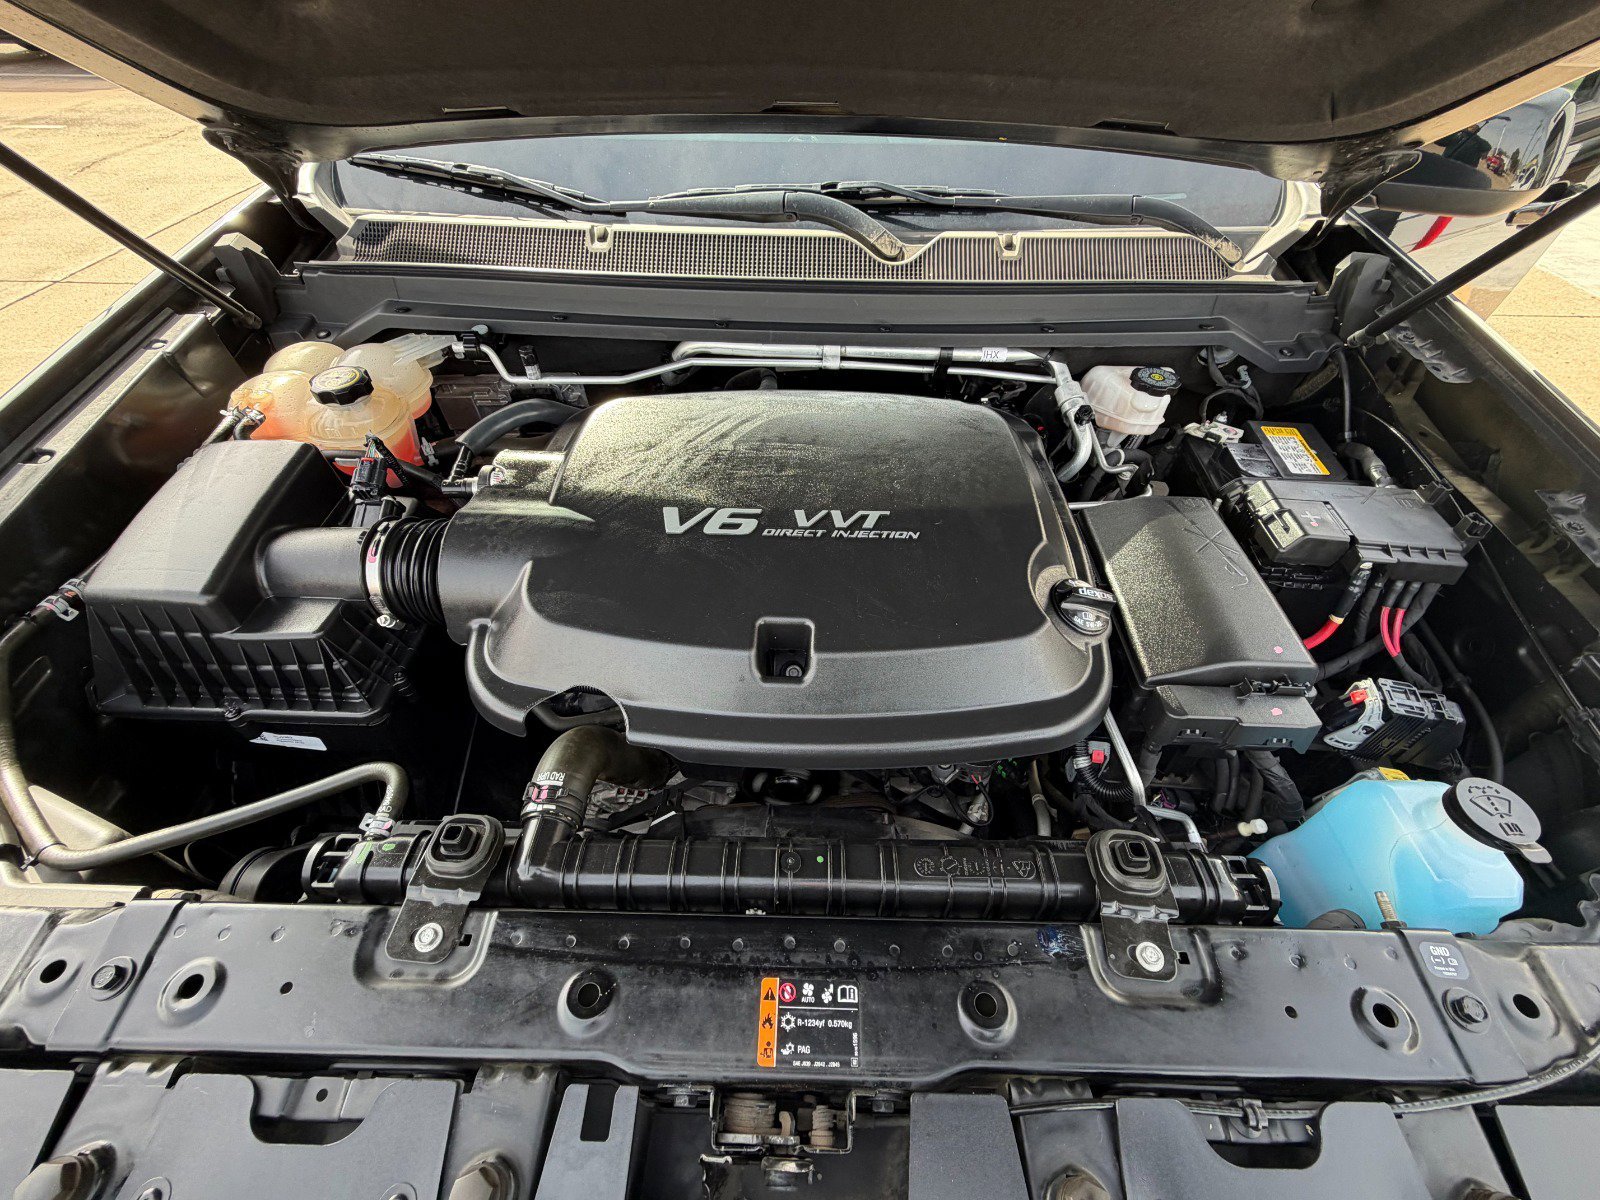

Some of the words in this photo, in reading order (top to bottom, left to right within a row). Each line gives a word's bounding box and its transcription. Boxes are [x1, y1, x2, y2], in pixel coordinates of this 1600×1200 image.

[662, 506, 763, 536] V6
[793, 509, 891, 529] VVT
[761, 528, 827, 538] DIRECT
[831, 529, 921, 539] INJECTION
[549, 771, 566, 781] RAD
[1429, 945, 1450, 957] GND
[801, 996, 815, 1004] AUTO
[797, 1018, 826, 1029] R-1234yf
[827, 1019, 853, 1030] 0.570kg
[797, 1045, 811, 1055] PAG
